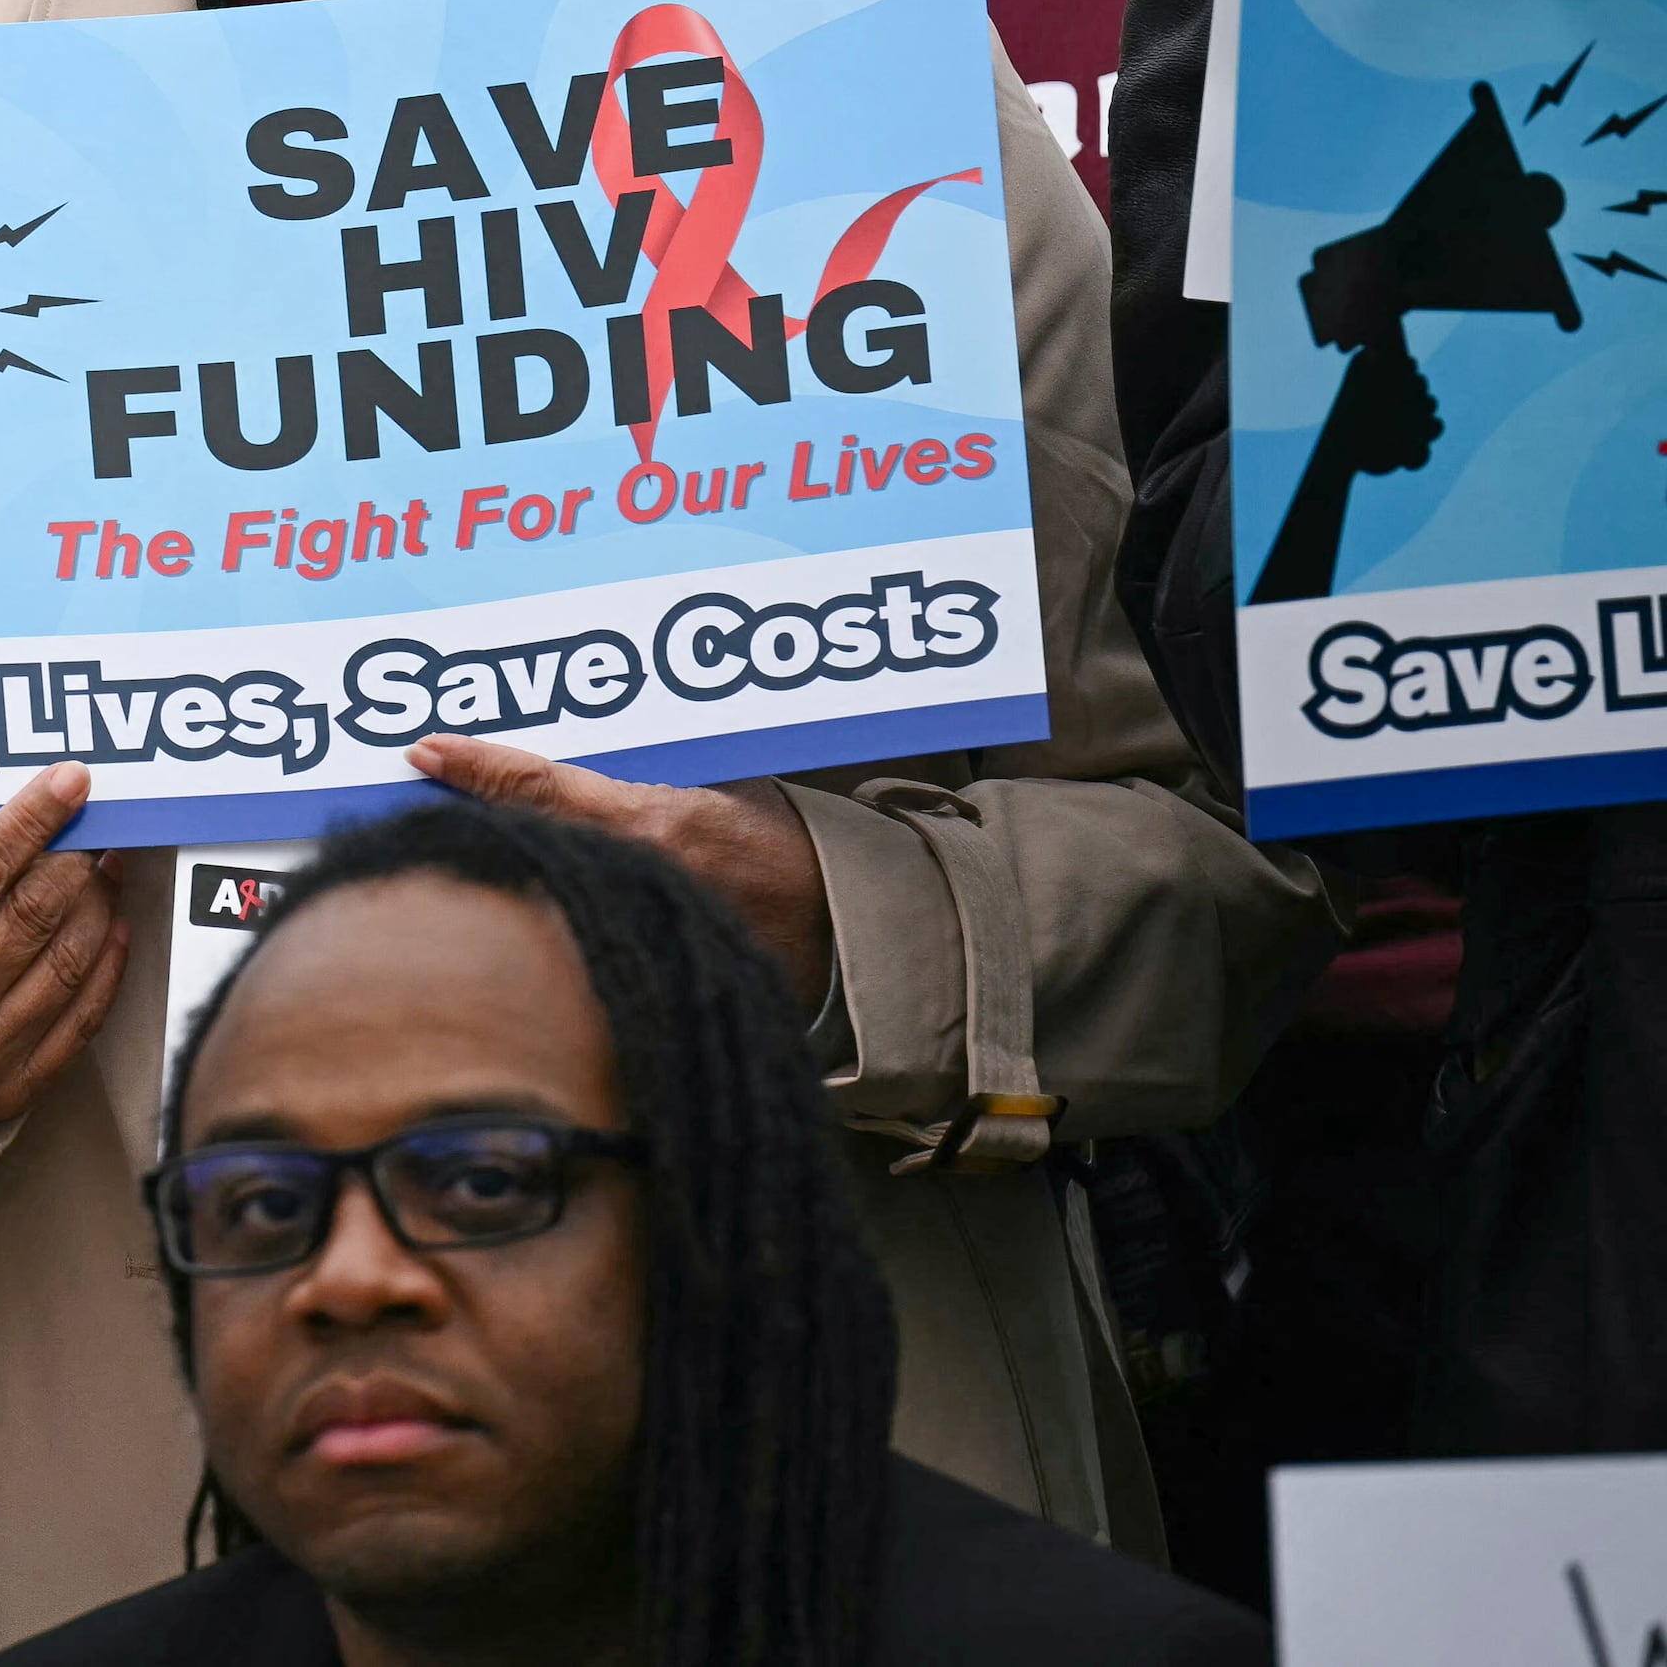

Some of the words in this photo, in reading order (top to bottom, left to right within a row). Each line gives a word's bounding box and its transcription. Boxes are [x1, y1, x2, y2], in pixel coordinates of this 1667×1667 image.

[245, 56, 734, 221] SAVE
[341, 189, 656, 337] HIV
[86, 279, 932, 479] FUNDING
[47, 518, 195, 581] The
[220, 500, 430, 580] Fight
[455, 483, 592, 553] For
[615, 459, 765, 524] Our
[788, 429, 998, 501] Lives
[337, 628, 645, 753] Save
[652, 571, 1000, 708] Costs
[1302, 620, 1593, 739] Save
